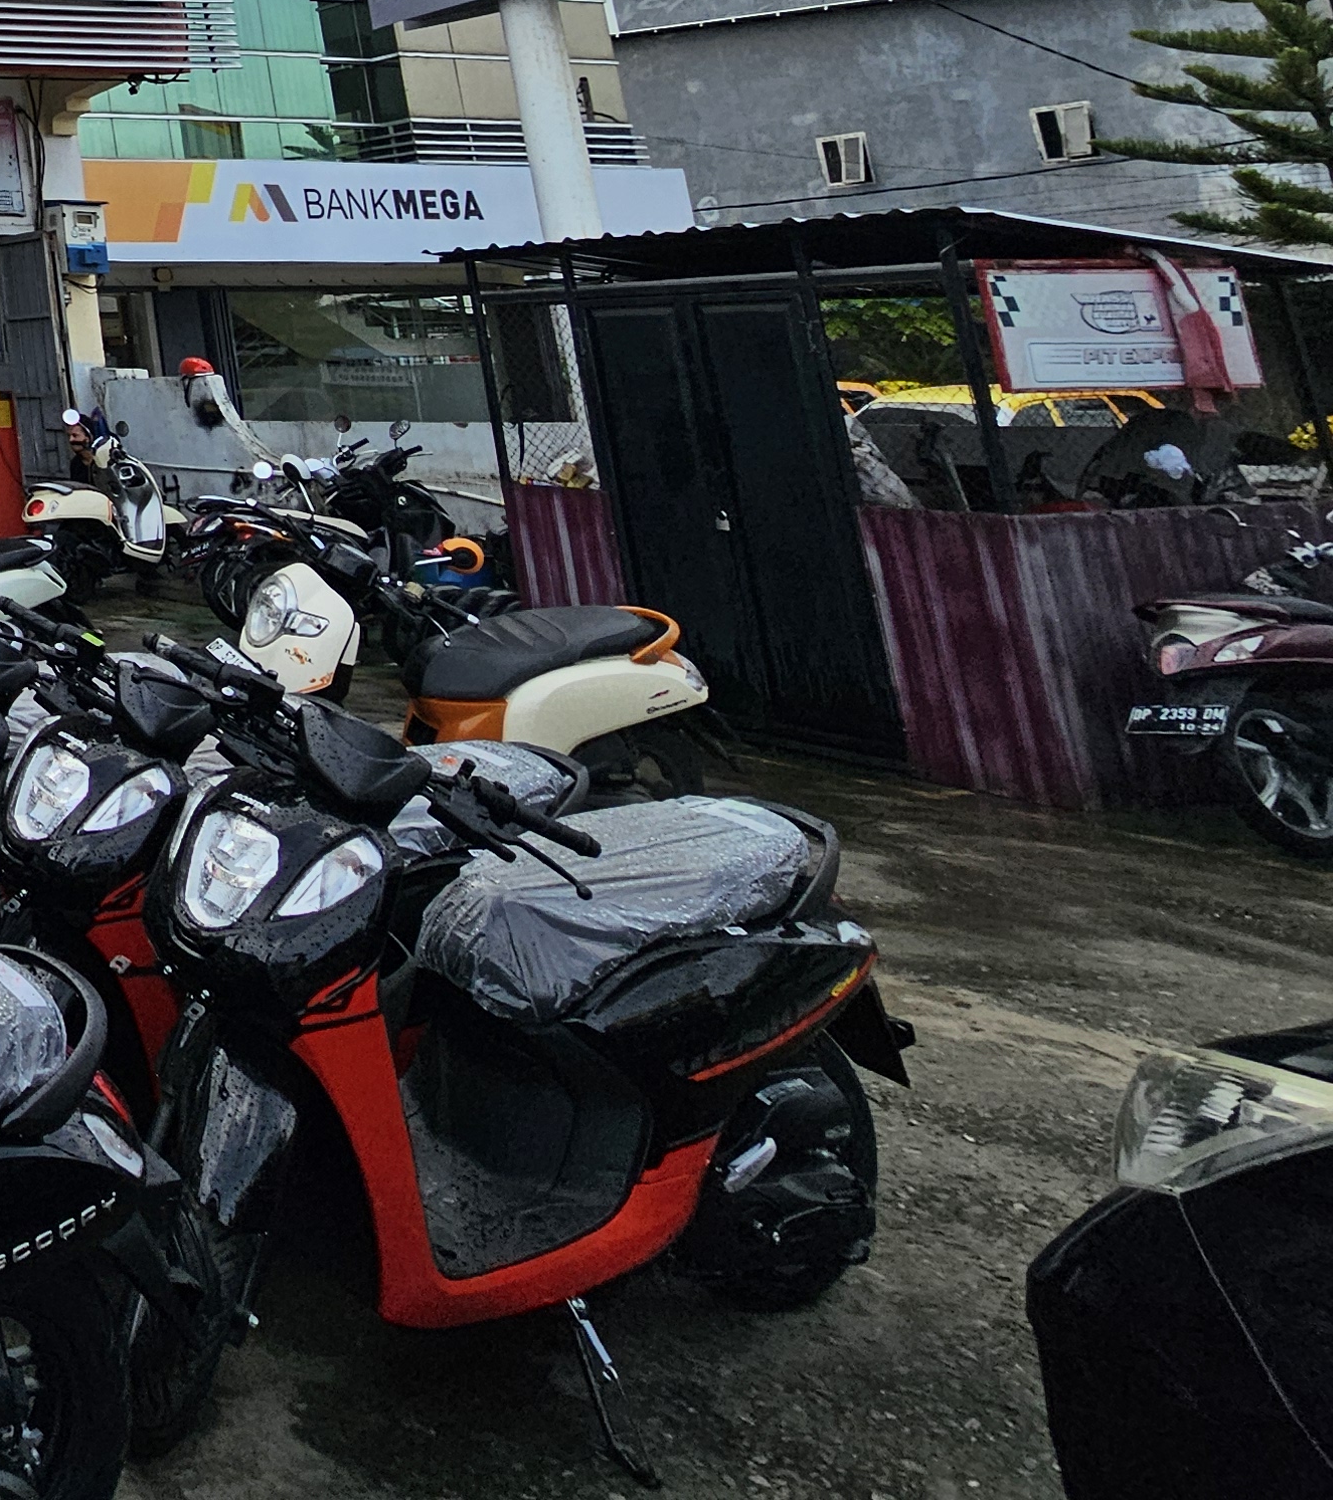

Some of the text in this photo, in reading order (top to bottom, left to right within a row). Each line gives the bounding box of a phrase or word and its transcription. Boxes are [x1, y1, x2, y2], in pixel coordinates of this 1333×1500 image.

[303, 188, 485, 221] BANKMEGA
[1133, 707, 1226, 721] DP 2359 DM
